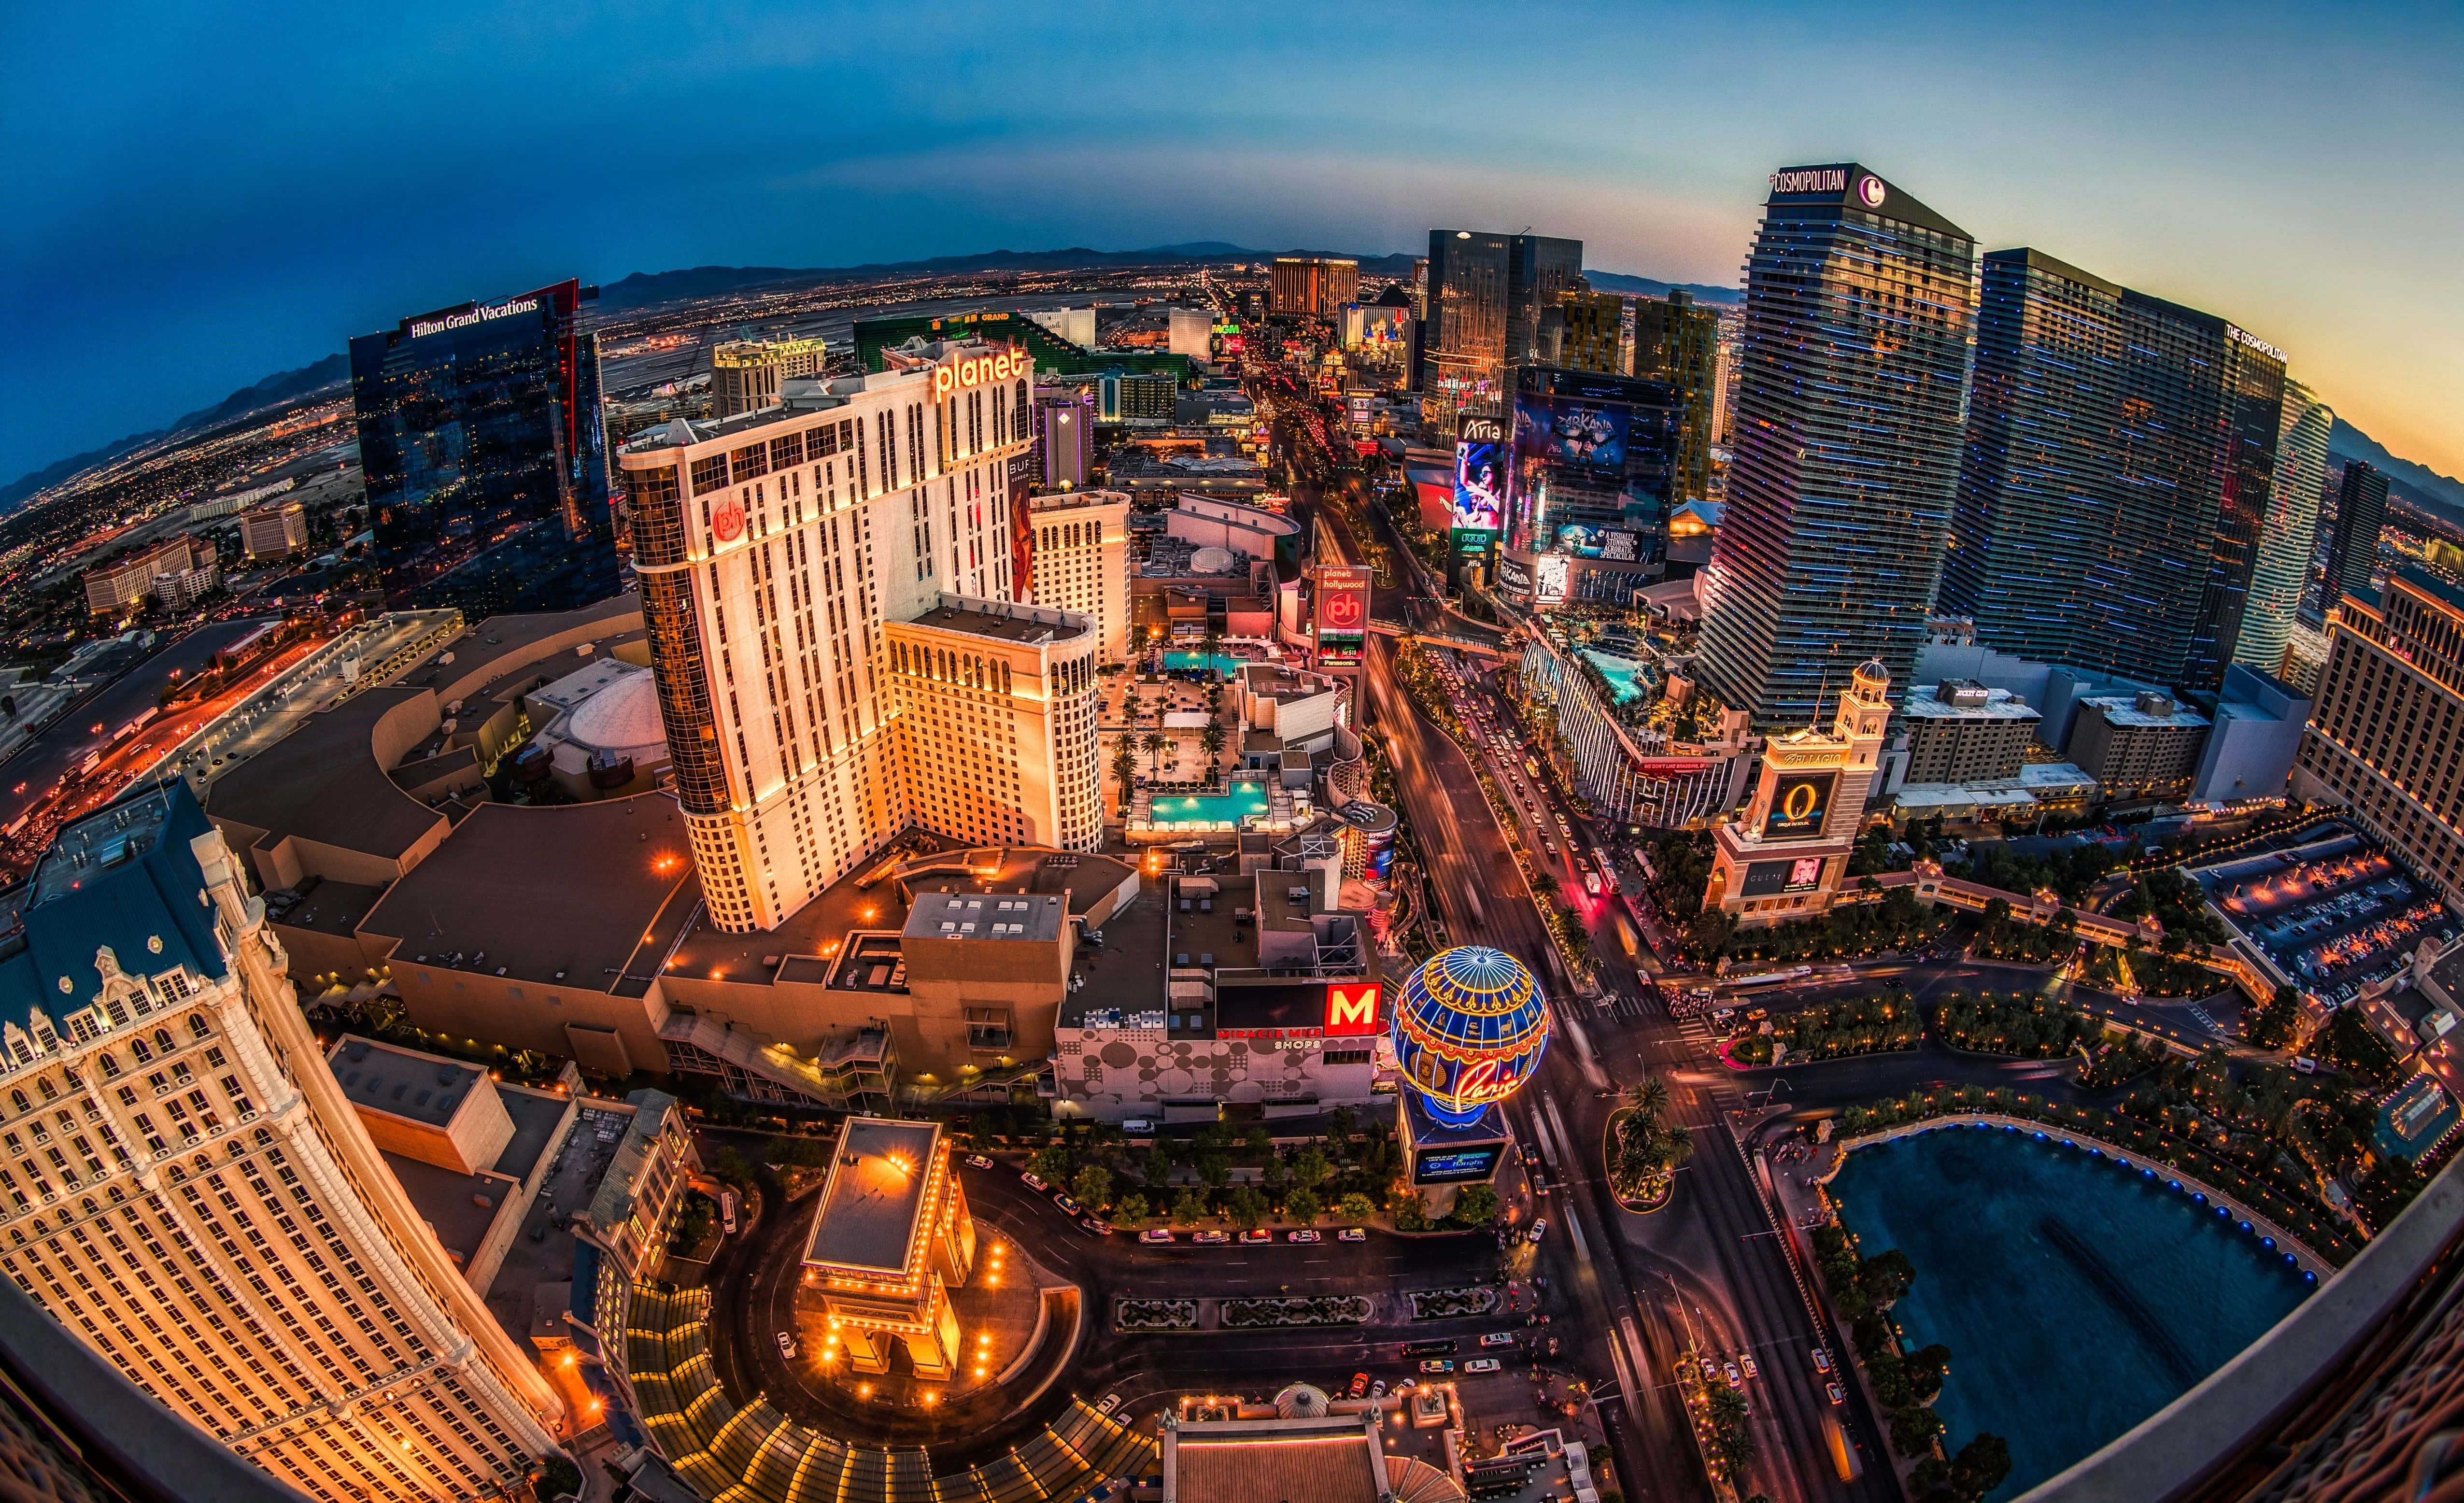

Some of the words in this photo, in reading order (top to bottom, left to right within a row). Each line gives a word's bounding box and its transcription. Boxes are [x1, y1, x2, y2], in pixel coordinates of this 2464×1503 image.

[1775, 170, 1844, 192] COSMOPOLITAN
[412, 321, 445, 338] Hilton
[446, 310, 479, 329] Grand
[480, 299, 538, 321] Vacations
[1211, 325, 1240, 334] MGM
[2226, 324, 2240, 341] THE
[2241, 332, 2288, 364] COSMOPOLITAN
[935, 345, 1024, 404] planet
[1464, 420, 1501, 440] Aria
[1547, 443, 1562, 453] Aria
[1461, 534, 1487, 542] LIQUID
[1610, 532, 1635, 541] VISUALLY
[1606, 539, 1632, 547] STUNNING
[1604, 545, 1633, 554] ACROBATIC
[1600, 551, 1635, 561] SPECTACULAR
[1324, 569, 1351, 579] planet
[1324, 581, 1364, 590] hollywood
[1512, 586, 1530, 595] DISBELIEF
[1781, 753, 1842, 765] BELLAGIO
[1784, 784, 1816, 820] O
[1331, 989, 1376, 1025] M
[1218, 1029, 1283, 1038] MIRACLE
[1289, 1028, 1322, 1038] MILE
[1274, 1040, 1321, 1050] SHOPS
[1456, 1058, 1519, 1113] Paris
